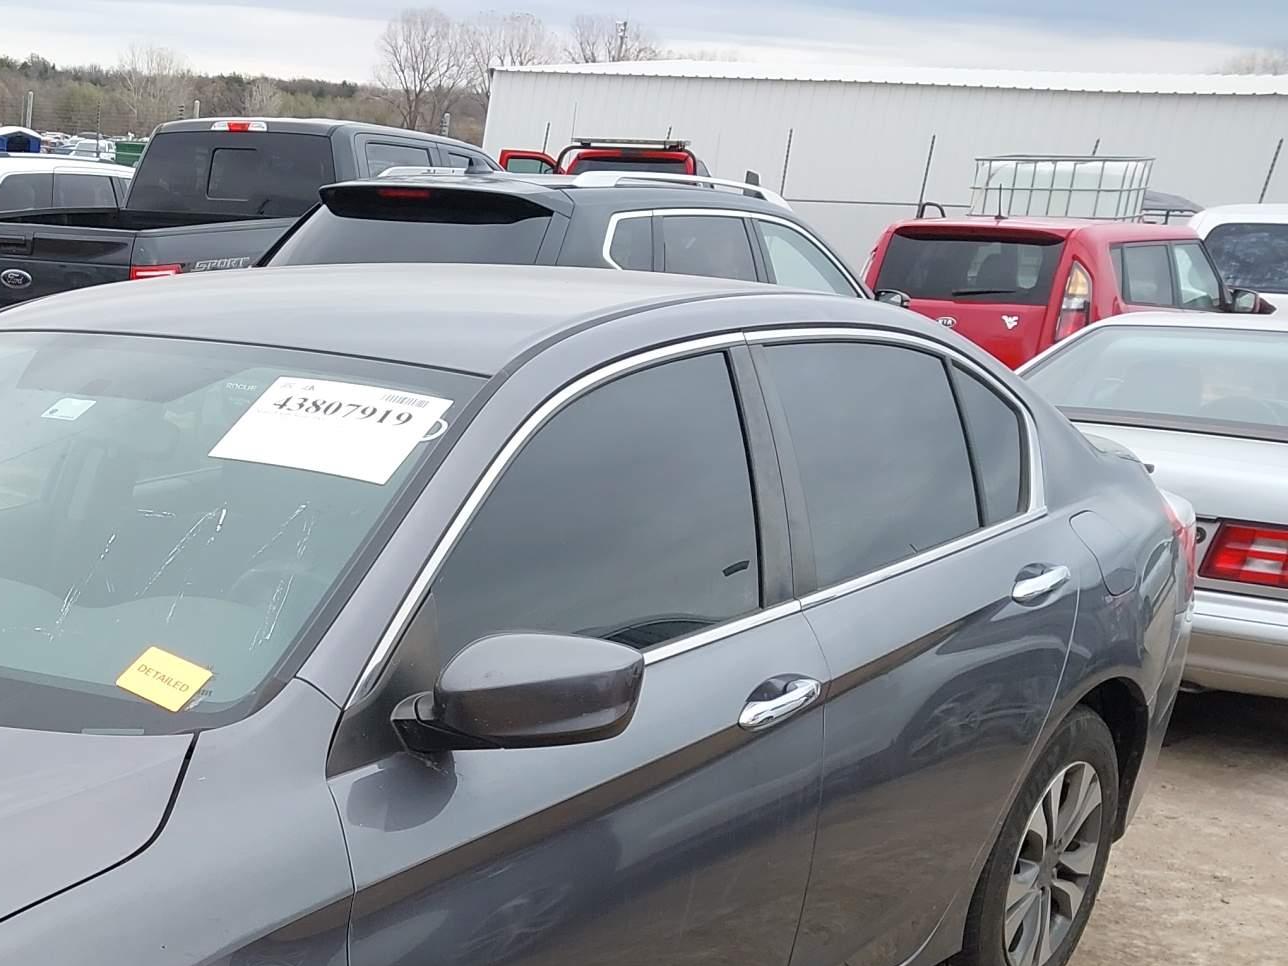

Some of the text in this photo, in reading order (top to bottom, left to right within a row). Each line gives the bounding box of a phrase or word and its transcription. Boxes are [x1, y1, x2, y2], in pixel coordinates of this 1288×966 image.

[191, 256, 251, 272] SPORT
[273, 395, 413, 426] 43807919
[137, 664, 190, 693] DETAILED
